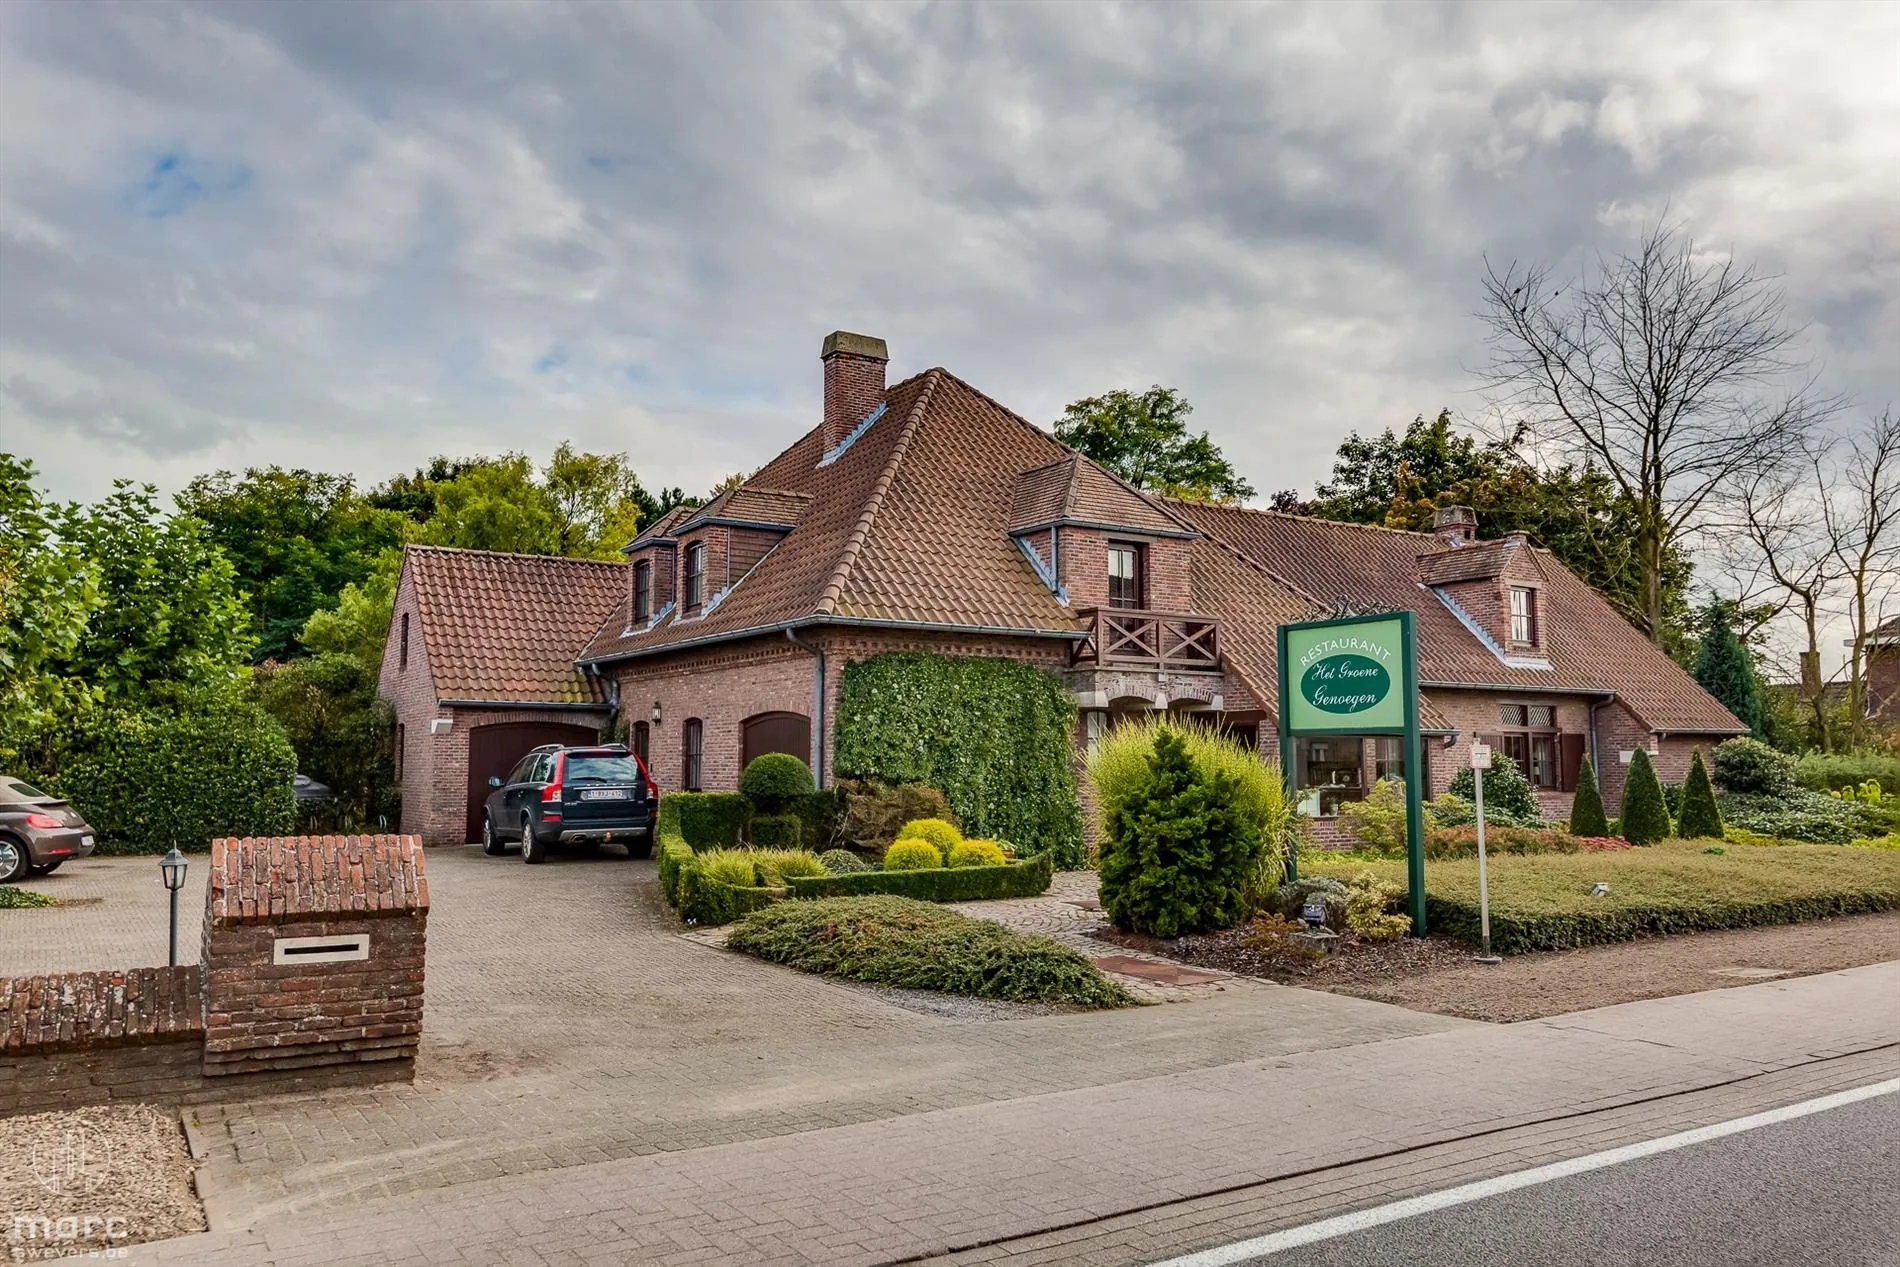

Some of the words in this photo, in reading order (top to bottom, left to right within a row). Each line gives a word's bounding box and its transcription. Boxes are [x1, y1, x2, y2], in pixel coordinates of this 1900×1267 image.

[1300, 638, 1391, 666] RESTAURANT
[1311, 662, 1334, 680] Het
[1338, 660, 1378, 679] Groene
[1312, 685, 1377, 712] Genoegen
